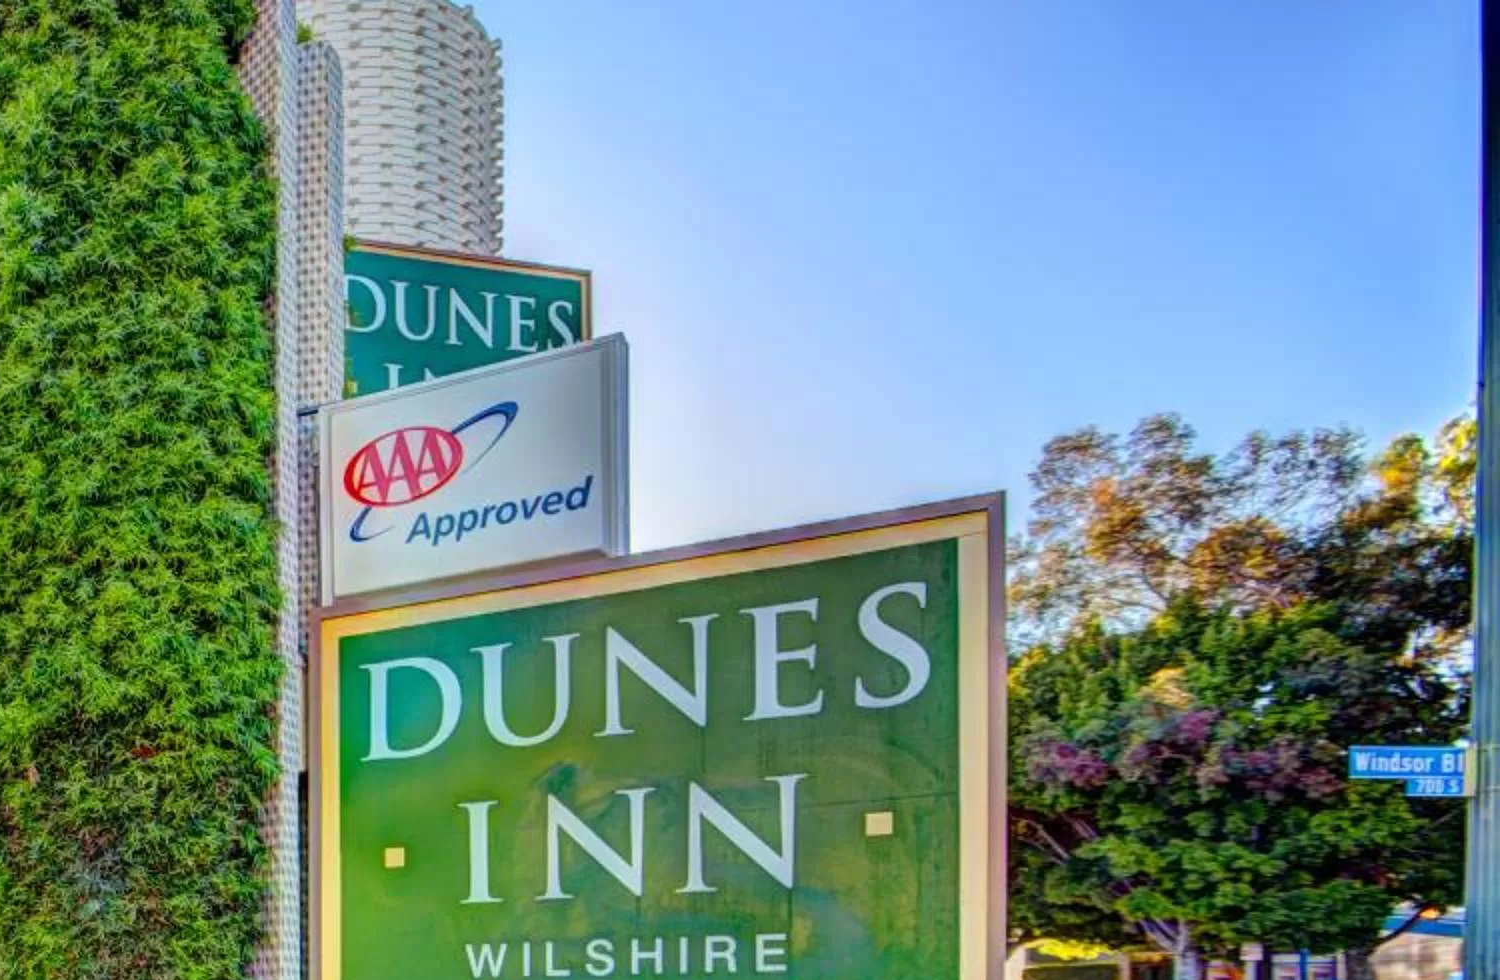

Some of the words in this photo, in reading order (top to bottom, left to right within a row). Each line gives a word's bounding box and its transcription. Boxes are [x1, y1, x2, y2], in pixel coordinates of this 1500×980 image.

[344, 274, 577, 353] DUNES
[355, 430, 455, 504] AAA
[406, 474, 594, 547] Approved
[359, 581, 932, 763] DUNES
[1355, 752, 1434, 772] Windsor
[1415, 779, 1444, 793] 700
[457, 773, 809, 906] INN
[465, 933, 789, 979] WILSHIRE
